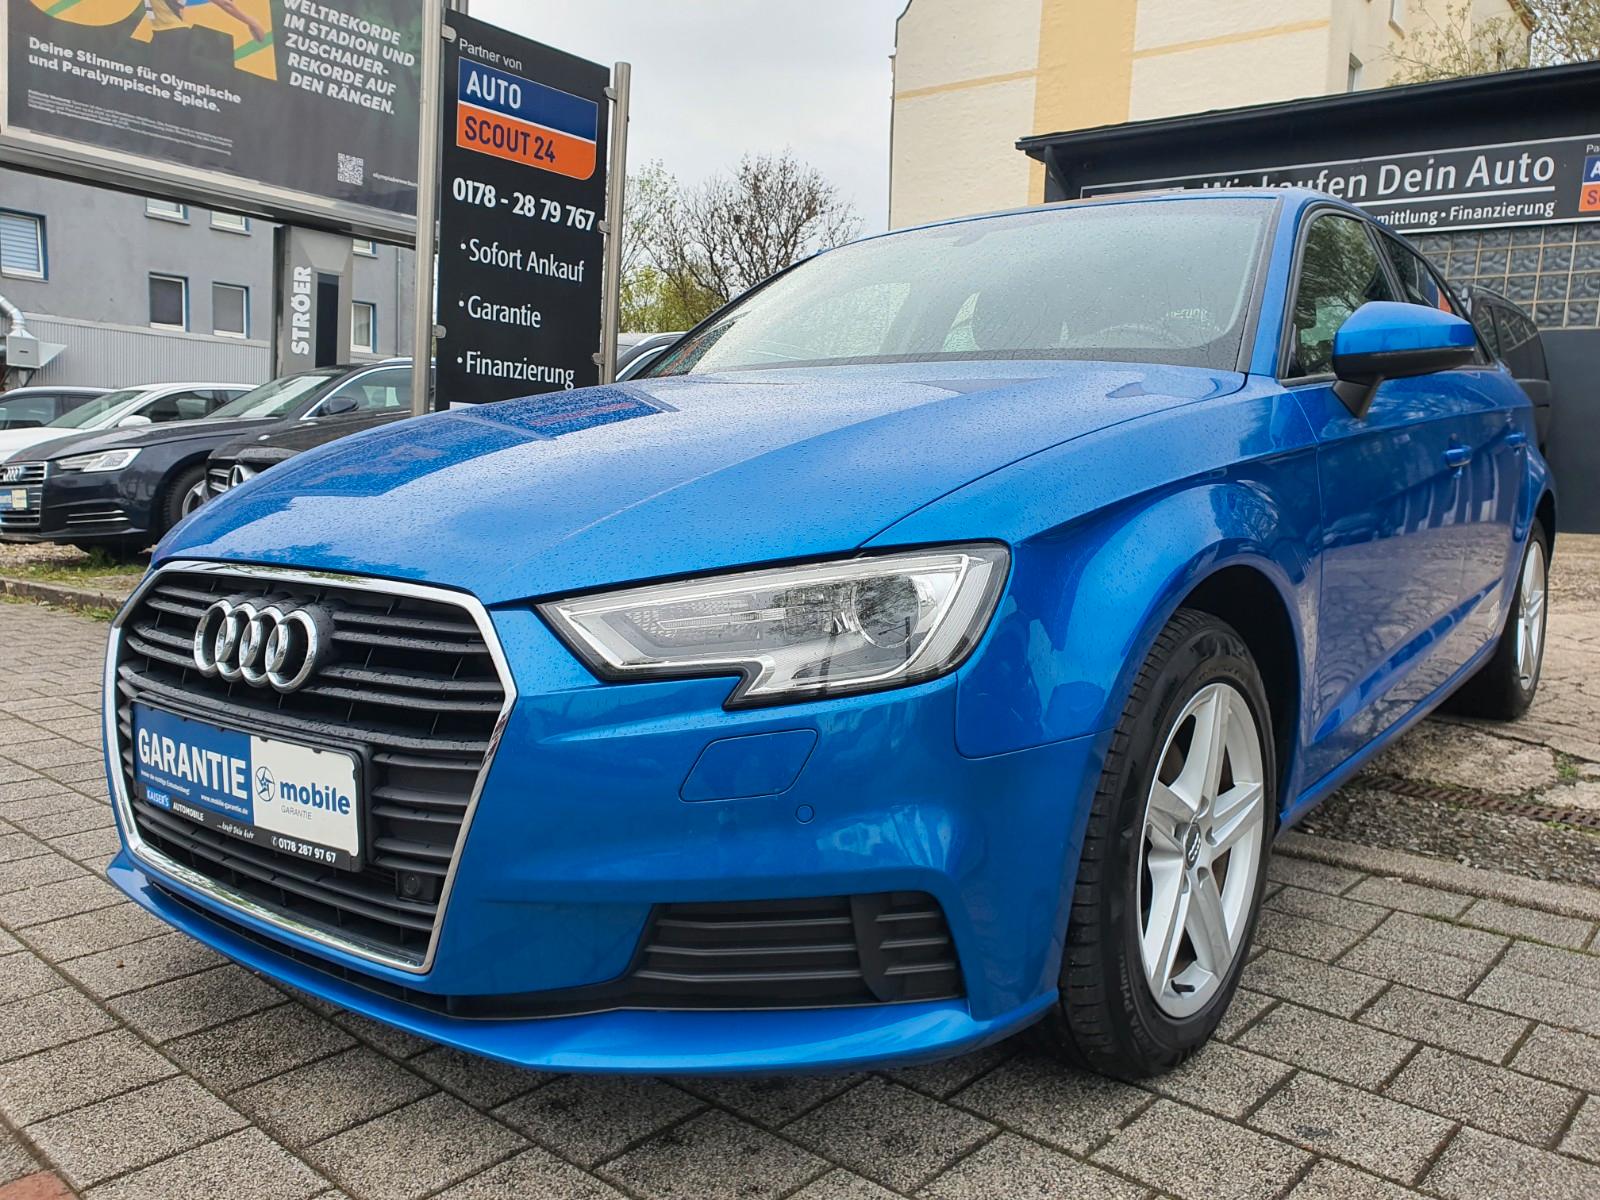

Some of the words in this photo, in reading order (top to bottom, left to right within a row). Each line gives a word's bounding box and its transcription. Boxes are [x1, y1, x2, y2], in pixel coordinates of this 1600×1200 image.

[283, 0, 401, 46] WELTREKORDE
[283, 13, 305, 31] IM
[308, 21, 379, 56] STADION
[382, 45, 415, 67] UND
[29, 36, 74, 58] Deine
[76, 49, 134, 74] Stimme
[136, 65, 158, 81] für
[160, 73, 241, 104] Olympische
[285, 33, 389, 76] ZUSCHAUER-
[287, 52, 364, 88] REKORDE
[365, 77, 397, 96] AUF
[459, 37, 500, 63] Partner
[502, 55, 522, 71] von
[28, 54, 59, 70] und
[62, 61, 171, 99] Paralympische
[173, 90, 221, 112] Spiele.
[289, 71, 324, 94] DEN
[326, 83, 395, 115] RÄNGEN.
[466, 70, 521, 109] AUTO
[1377, 158, 1457, 195] Dein
[1465, 152, 1555, 188] Auto
[452, 177, 496, 208] 0178
[512, 191, 536, 217] 28
[540, 198, 561, 223] 79
[565, 204, 596, 231] 767
[1374, 209, 1439, 226] mittlung
[1449, 202, 1555, 221] Finanzierung
[469, 238, 522, 270] Sofort
[526, 251, 585, 282] Ankauf
[290, 266, 312, 355] STRÖER
[467, 295, 541, 328] Garantie
[466, 350, 575, 390] Finanzierung
[138, 727, 248, 800] GARANTIE
[172, 801, 205, 822] AUTOMOBILE
[279, 781, 351, 815] mobile
[280, 804, 313, 820] GARANTIE
[278, 837, 297, 853] 0178
[298, 843, 313, 857] 287
[313, 847, 325, 861] 97
[325, 850, 337, 864] 67
